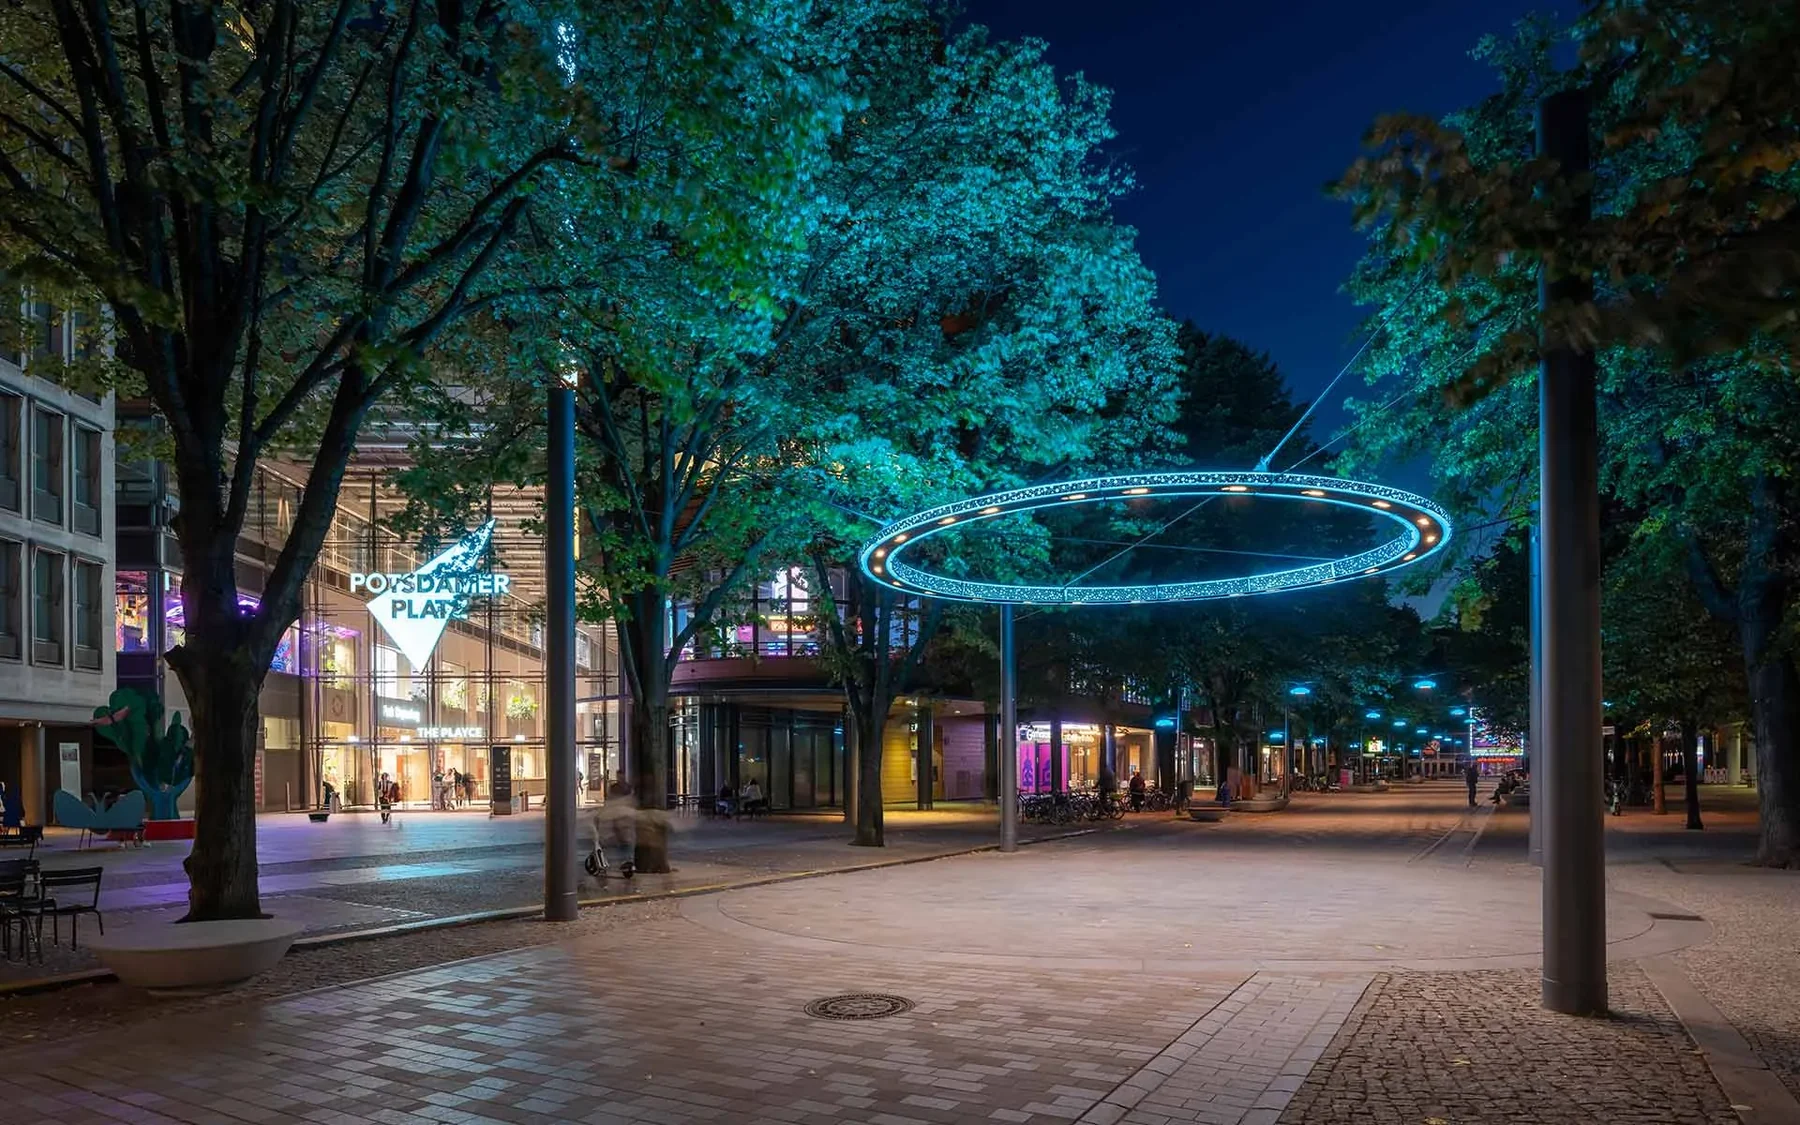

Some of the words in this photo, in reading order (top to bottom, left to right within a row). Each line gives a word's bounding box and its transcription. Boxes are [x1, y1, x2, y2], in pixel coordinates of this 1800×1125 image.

[350, 573, 510, 594] POTSDAMER
[391, 599, 469, 620] PLATZ
[417, 727, 439, 738] THE
[440, 727, 483, 738] PLAYCE
